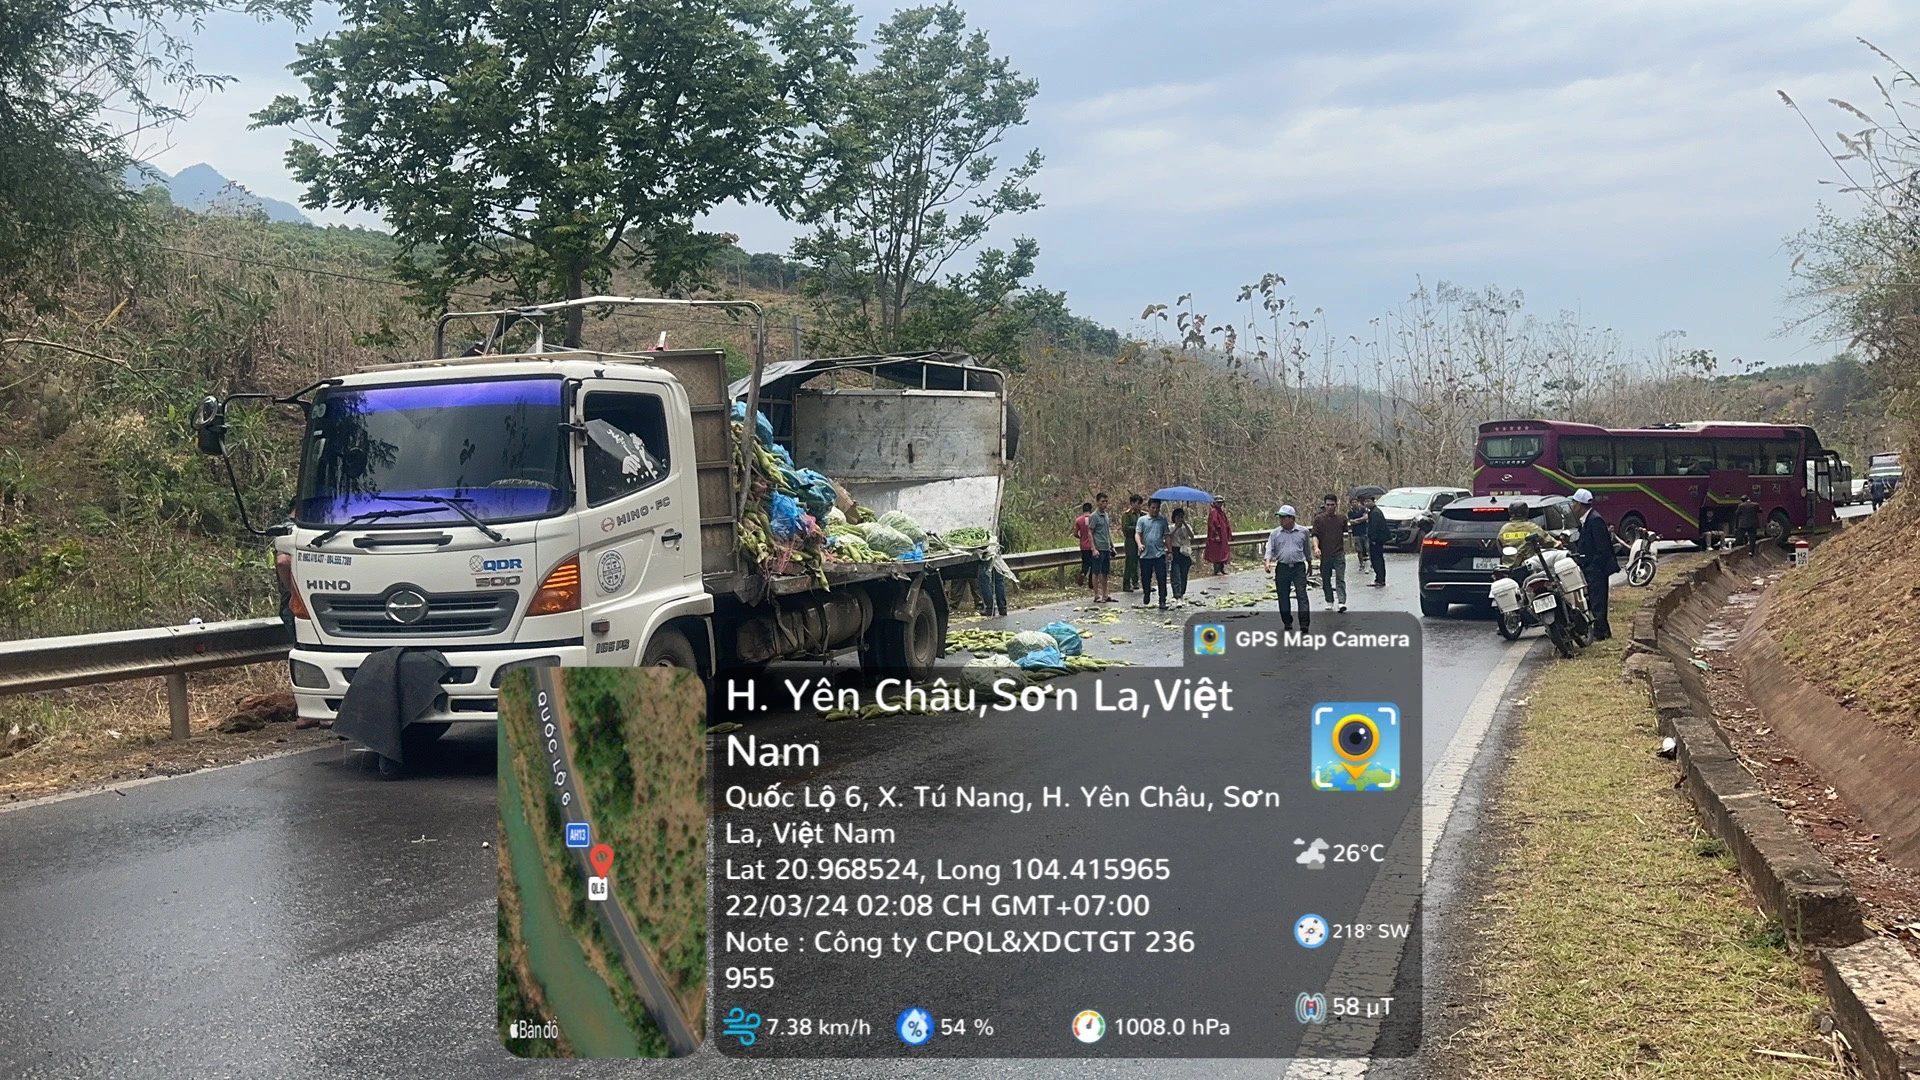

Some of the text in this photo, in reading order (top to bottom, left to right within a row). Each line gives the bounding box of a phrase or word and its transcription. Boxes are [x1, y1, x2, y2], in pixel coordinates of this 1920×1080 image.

[483, 558, 523, 571] QDR
[306, 579, 352, 591] HINO
[475, 575, 521, 588] 500
